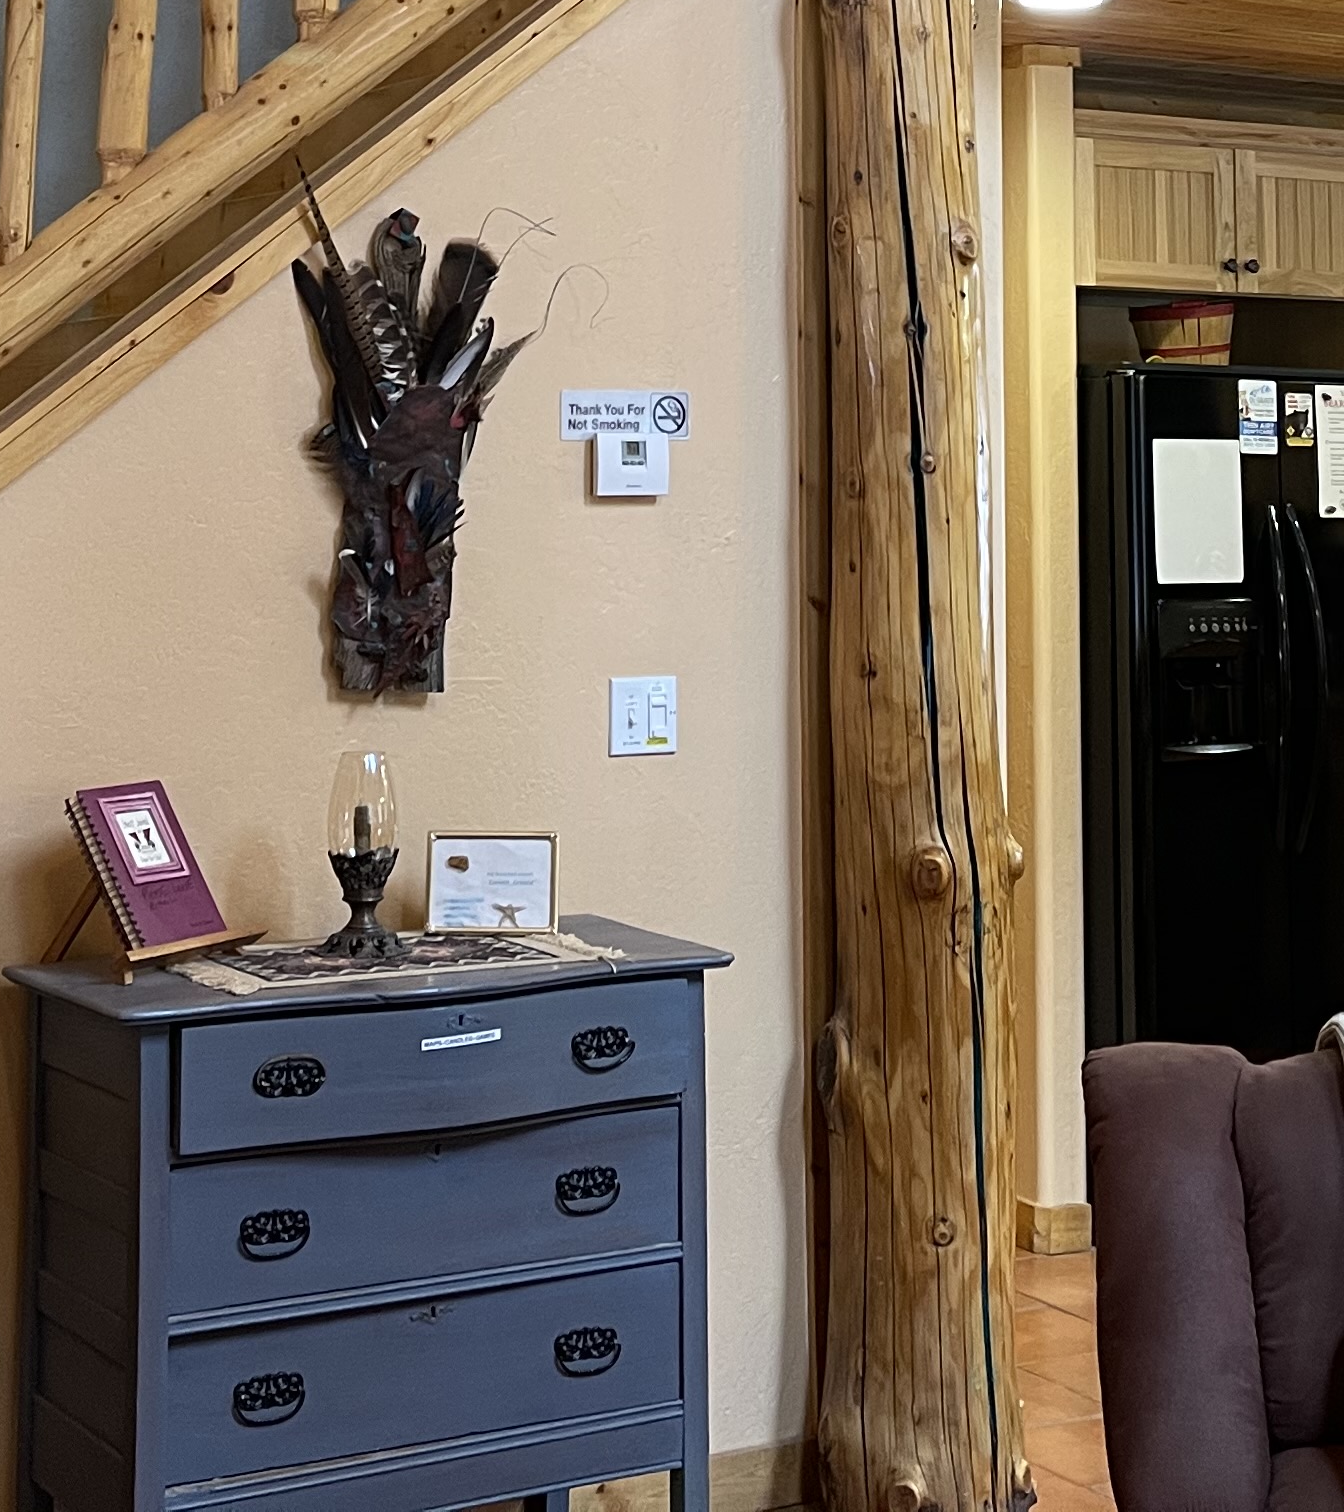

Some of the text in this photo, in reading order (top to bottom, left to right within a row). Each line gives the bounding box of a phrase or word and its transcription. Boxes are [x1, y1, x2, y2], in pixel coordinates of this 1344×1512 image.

[568, 403, 646, 416] Thank You For
[567, 418, 640, 432] Not Smoking
